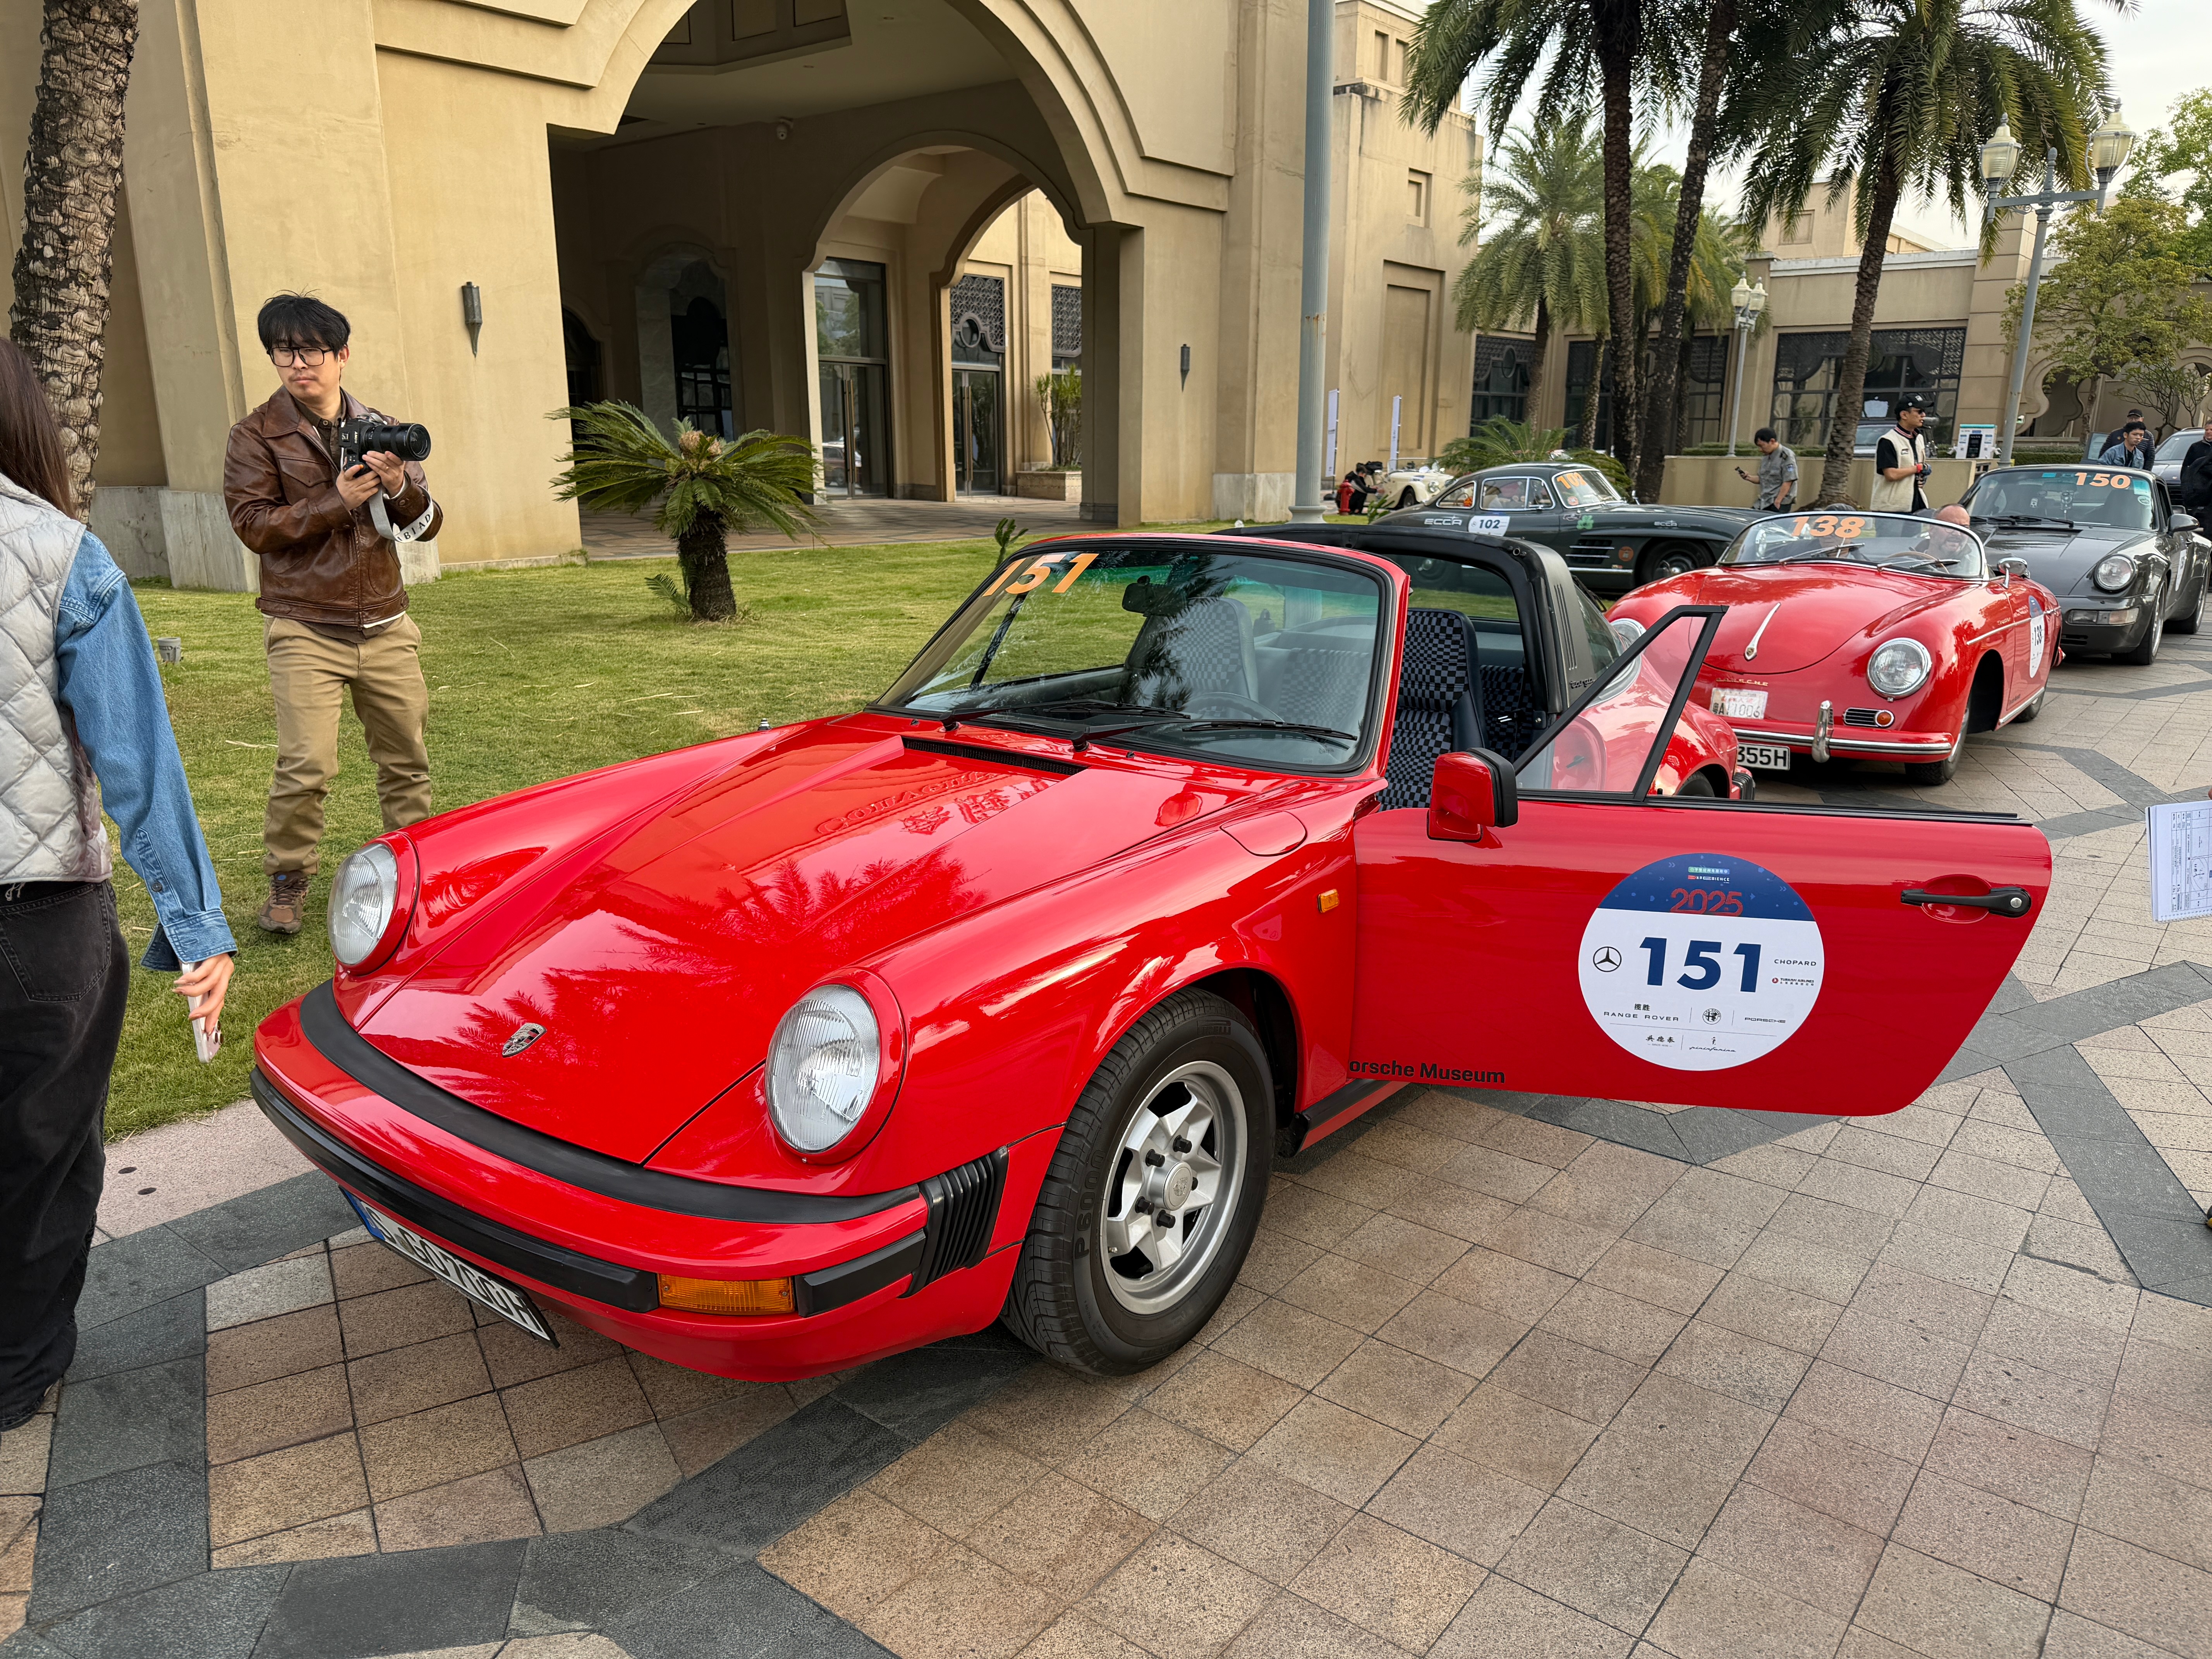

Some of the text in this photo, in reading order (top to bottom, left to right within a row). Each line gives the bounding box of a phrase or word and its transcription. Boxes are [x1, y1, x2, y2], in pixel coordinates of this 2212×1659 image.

[1557, 472, 1587, 489] 102
[2075, 472, 2131, 489] 150
[1479, 519, 1501, 529] 102
[1791, 515, 1865, 539] 138
[982, 553, 1100, 597] 151
[2034, 624, 2042, 646] 138
[1670, 888, 1743, 917] 2025
[1639, 937, 1761, 993] 151
[1634, 1003, 1650, 1011] 揽胜
[1349, 1060, 1506, 1084] orsche Museum
[1077, 1149, 1105, 1231] 6000
